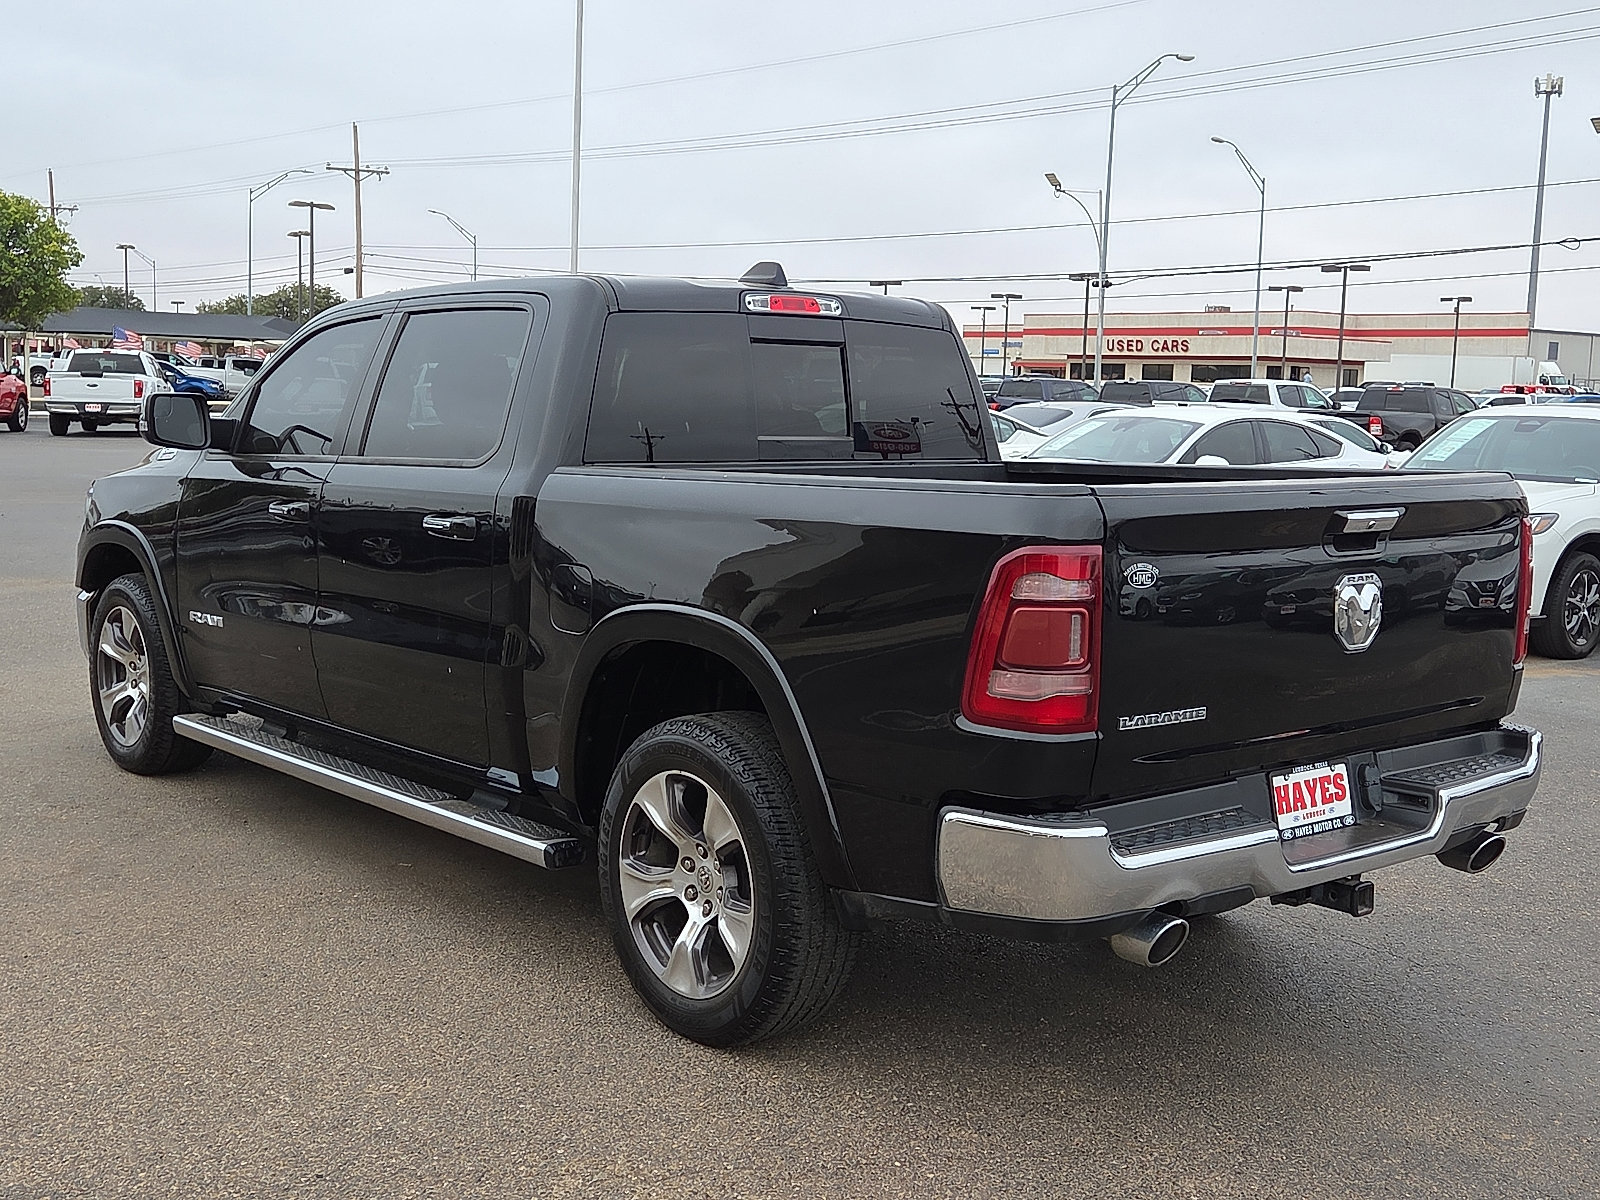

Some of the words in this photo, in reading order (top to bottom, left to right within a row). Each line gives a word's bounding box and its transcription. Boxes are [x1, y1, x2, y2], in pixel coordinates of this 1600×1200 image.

[1106, 338, 1144, 353] USED
[1151, 339, 1190, 353] CARS
[1347, 574, 1374, 583] RAM
[189, 610, 224, 628] RAM
[1118, 707, 1207, 730] LARAMIE
[1275, 773, 1347, 815] HAYES
[1295, 826, 1312, 837] HAYES
[1313, 821, 1332, 833] MOTOR
